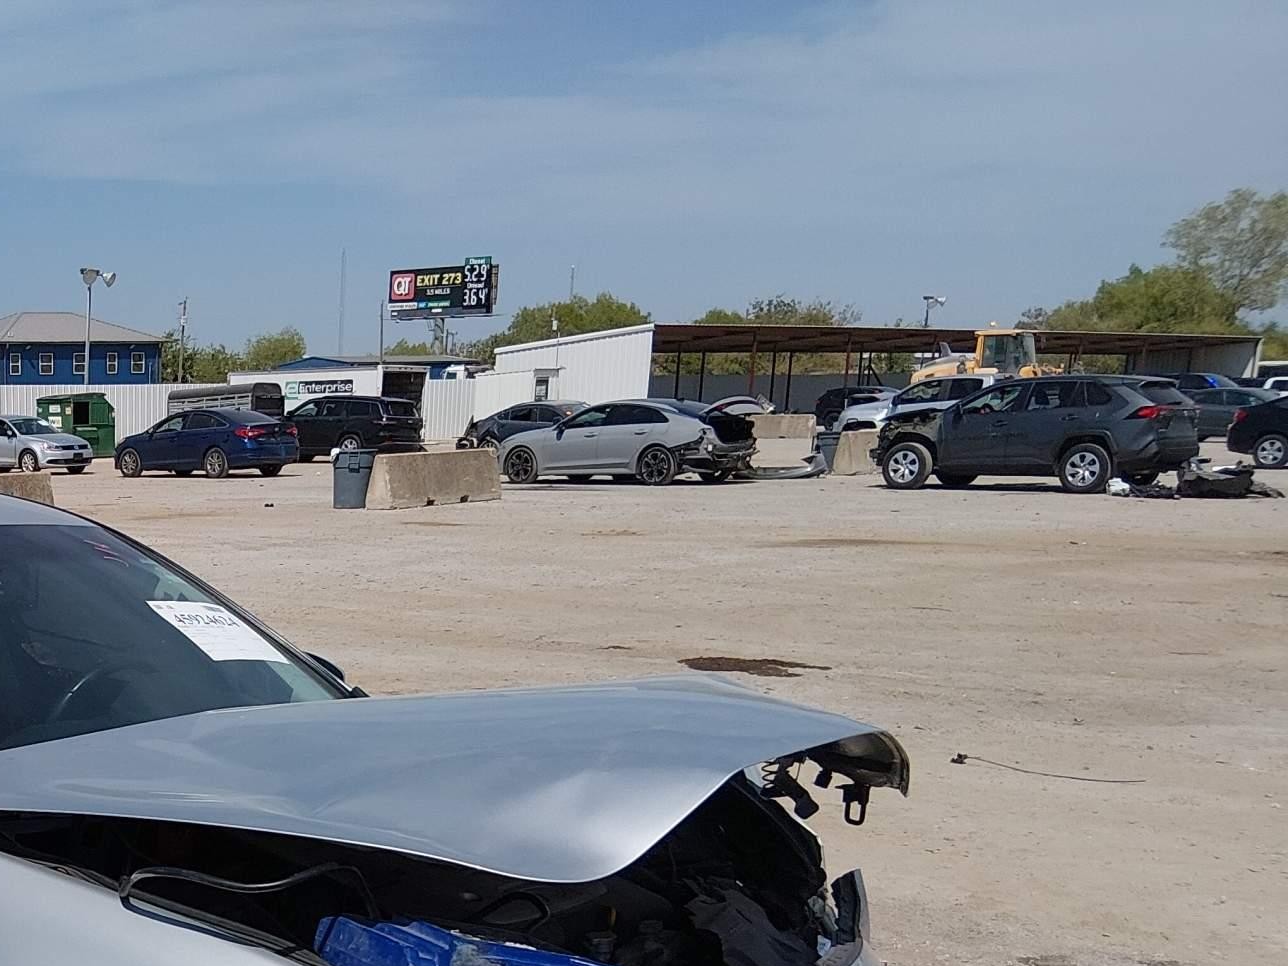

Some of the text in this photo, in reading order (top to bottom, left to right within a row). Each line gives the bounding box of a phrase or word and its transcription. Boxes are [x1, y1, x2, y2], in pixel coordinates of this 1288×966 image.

[394, 277, 412, 296] QT
[416, 272, 462, 287] EXIT 273
[299, 381, 352, 394] Enterprise
